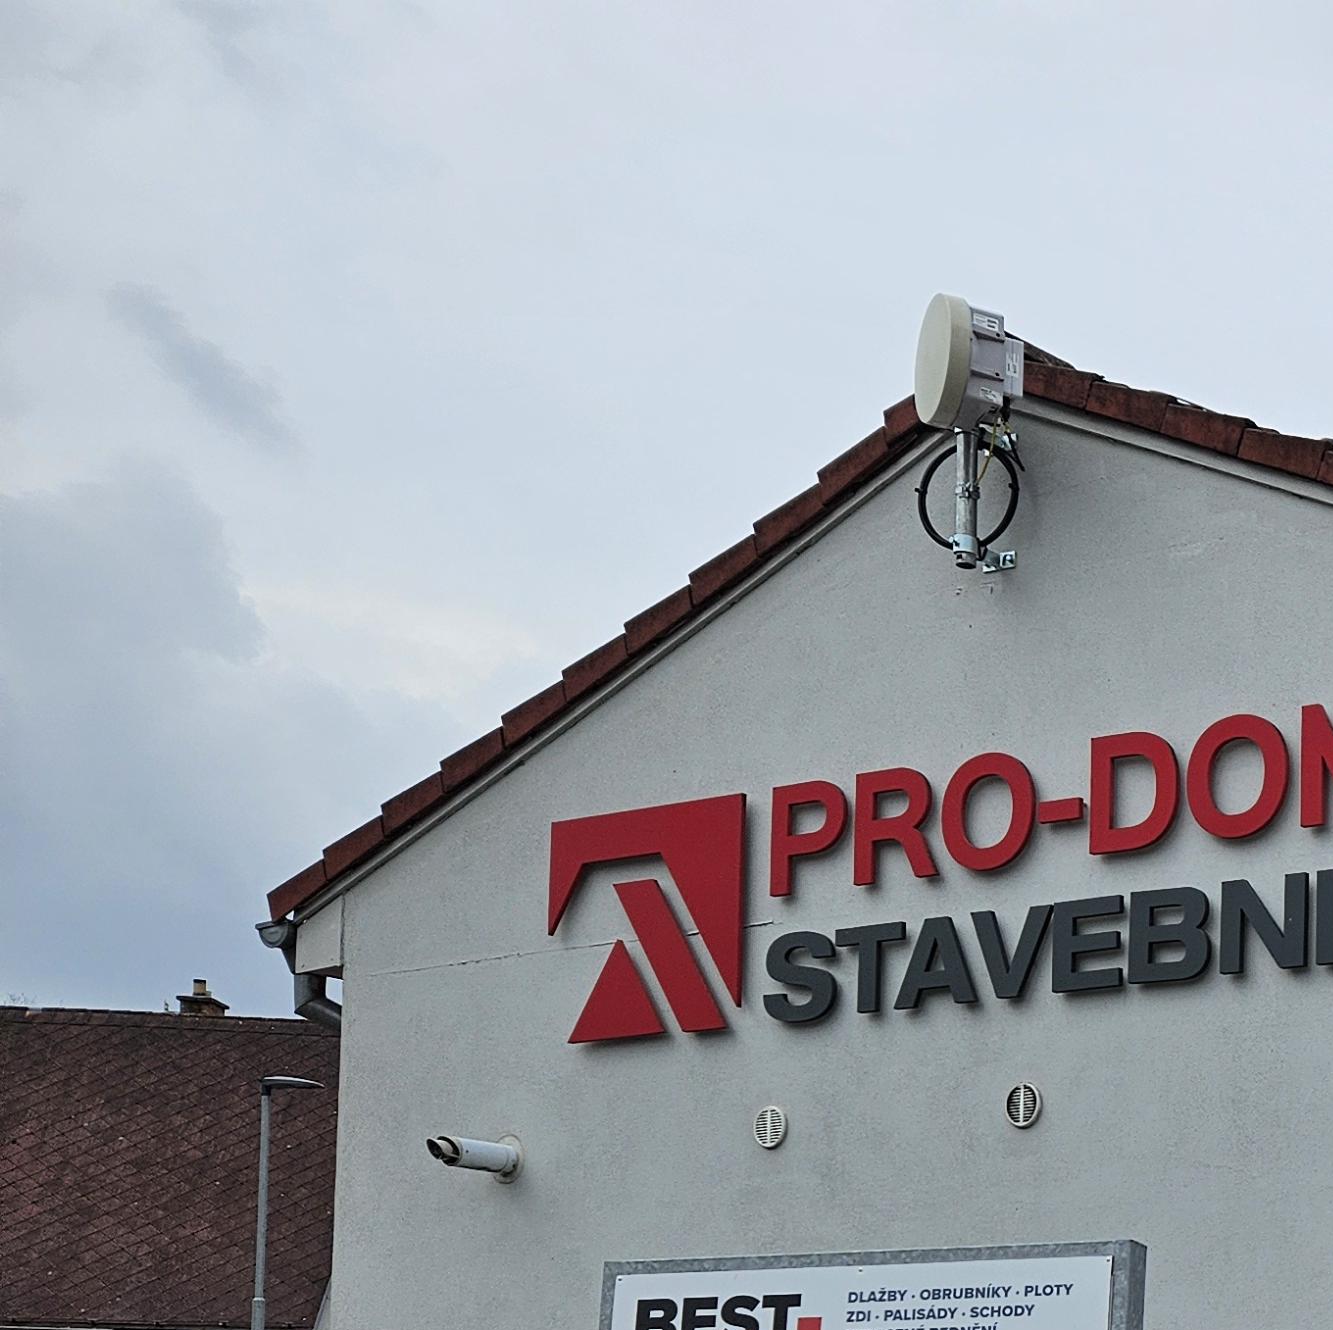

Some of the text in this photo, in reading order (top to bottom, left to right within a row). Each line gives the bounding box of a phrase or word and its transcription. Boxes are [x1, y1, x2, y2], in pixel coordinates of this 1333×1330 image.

[848, 1284, 1074, 1303] DLAŽBY OBRUBNÍKY PLOTY
[846, 1304, 1035, 1322] ZDI PALISÁDY SCHODY
